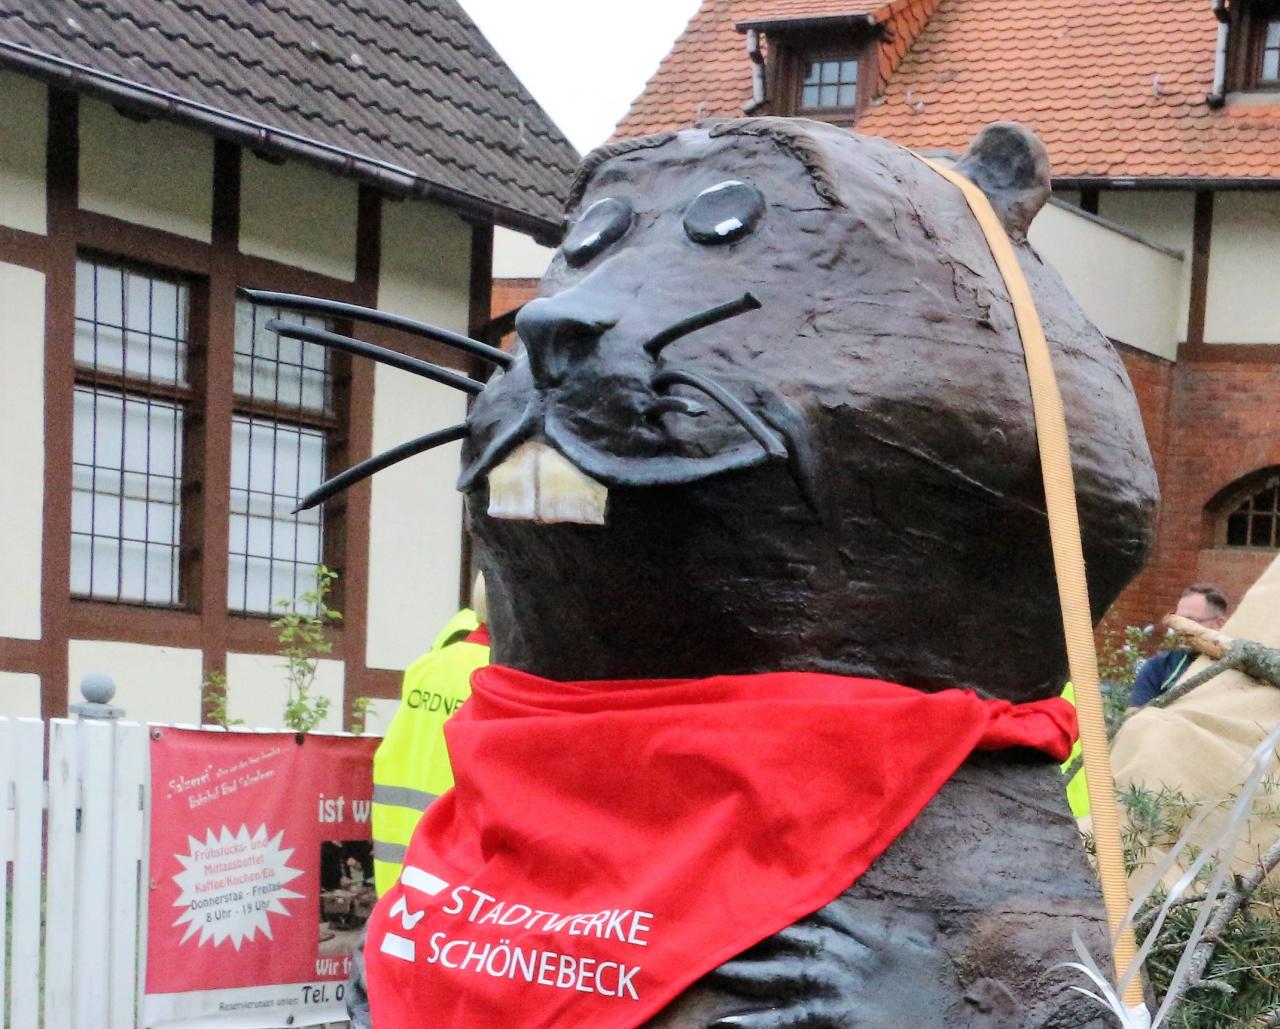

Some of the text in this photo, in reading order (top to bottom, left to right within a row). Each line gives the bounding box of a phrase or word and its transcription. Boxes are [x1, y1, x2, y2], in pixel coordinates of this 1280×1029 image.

[318, 793, 371, 823] ist w
[191, 892, 243, 910] Donnerstag
[215, 910, 231, 920] Uhr
[255, 900, 270, 911] Uhr
[442, 885, 654, 947] STADTWERKE
[315, 957, 340, 976] Wir
[426, 931, 641, 1000] SCHÖNEBECK
[302, 984, 330, 1004] Tel.
[335, 983, 346, 1002] 0
